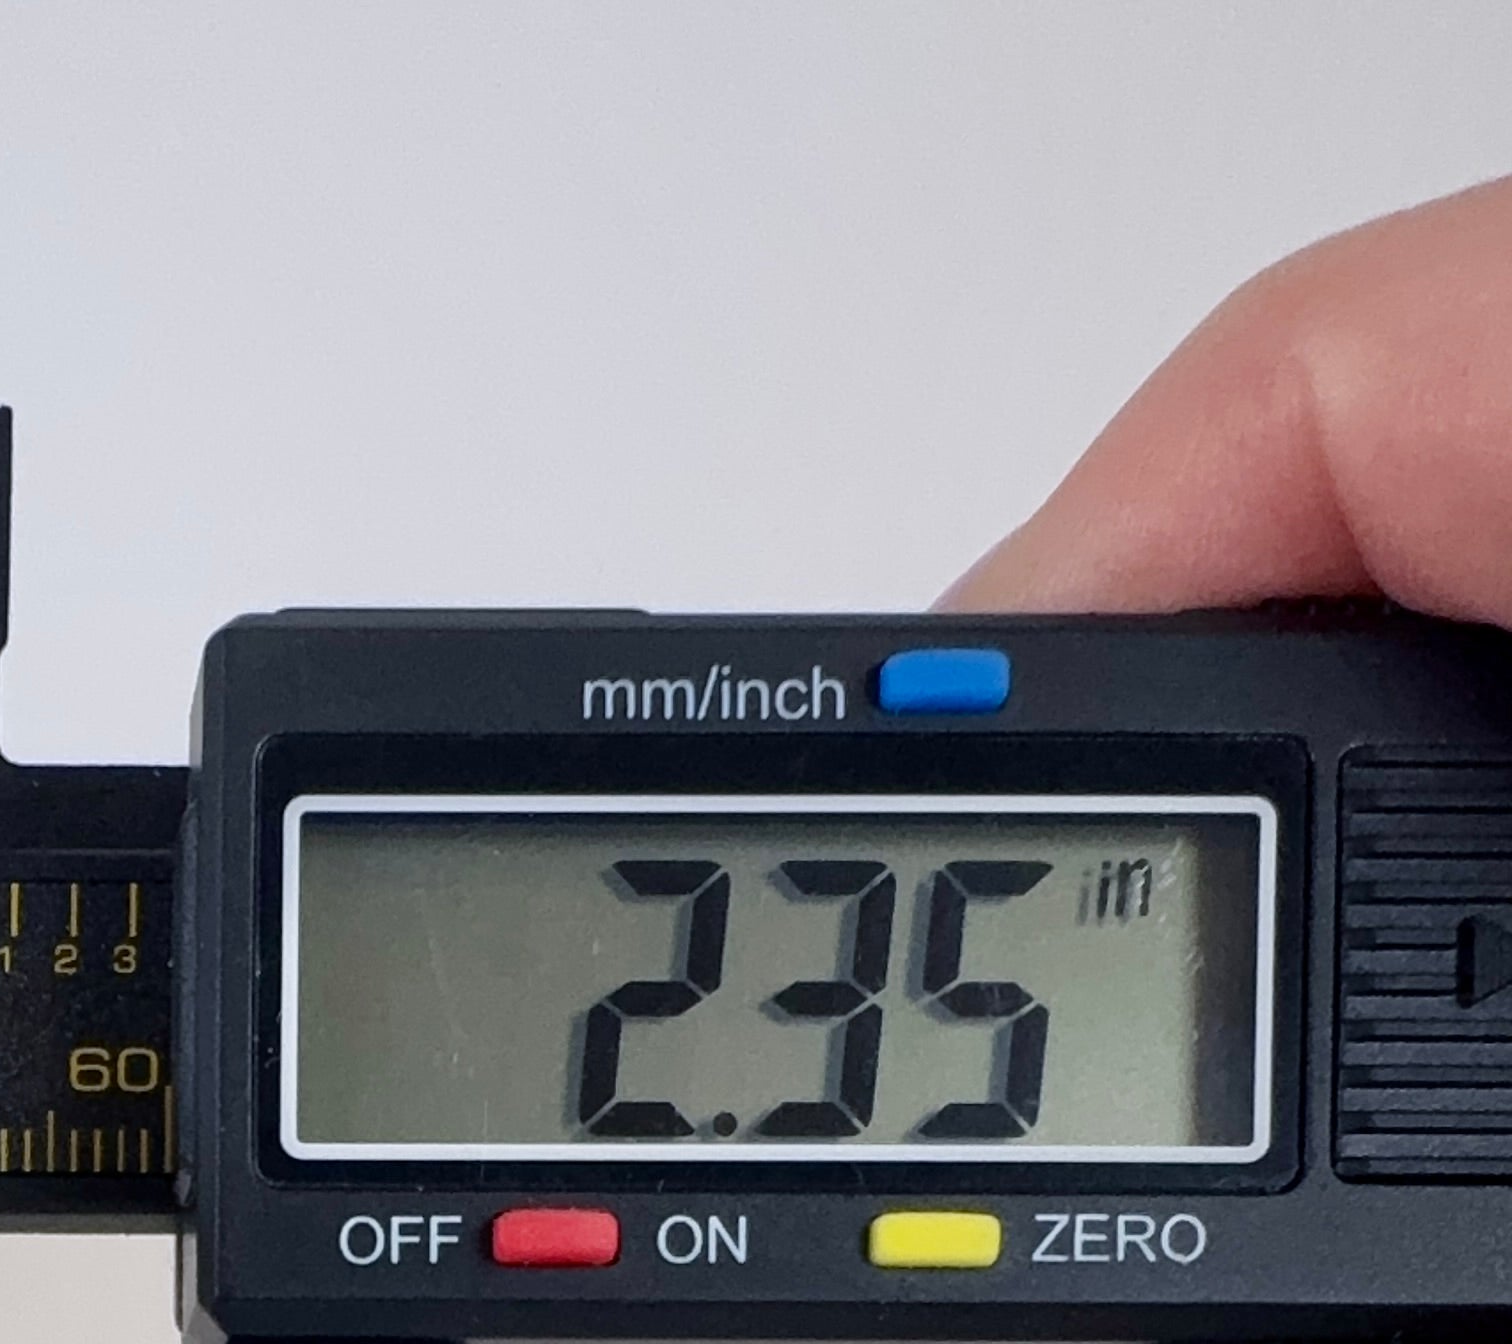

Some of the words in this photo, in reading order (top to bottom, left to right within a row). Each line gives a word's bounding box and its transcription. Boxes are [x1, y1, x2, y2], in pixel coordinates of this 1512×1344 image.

[583, 664, 846, 721] mm/inch
[53, 943, 78, 976] 2
[113, 943, 137, 974] 3
[578, 859, 1053, 1138] 2.35
[1094, 857, 1151, 918] in
[69, 1047, 159, 1093] 60
[339, 1215, 463, 1265] OFF
[657, 1214, 747, 1264] ON
[1031, 1213, 1207, 1265] ZERO
